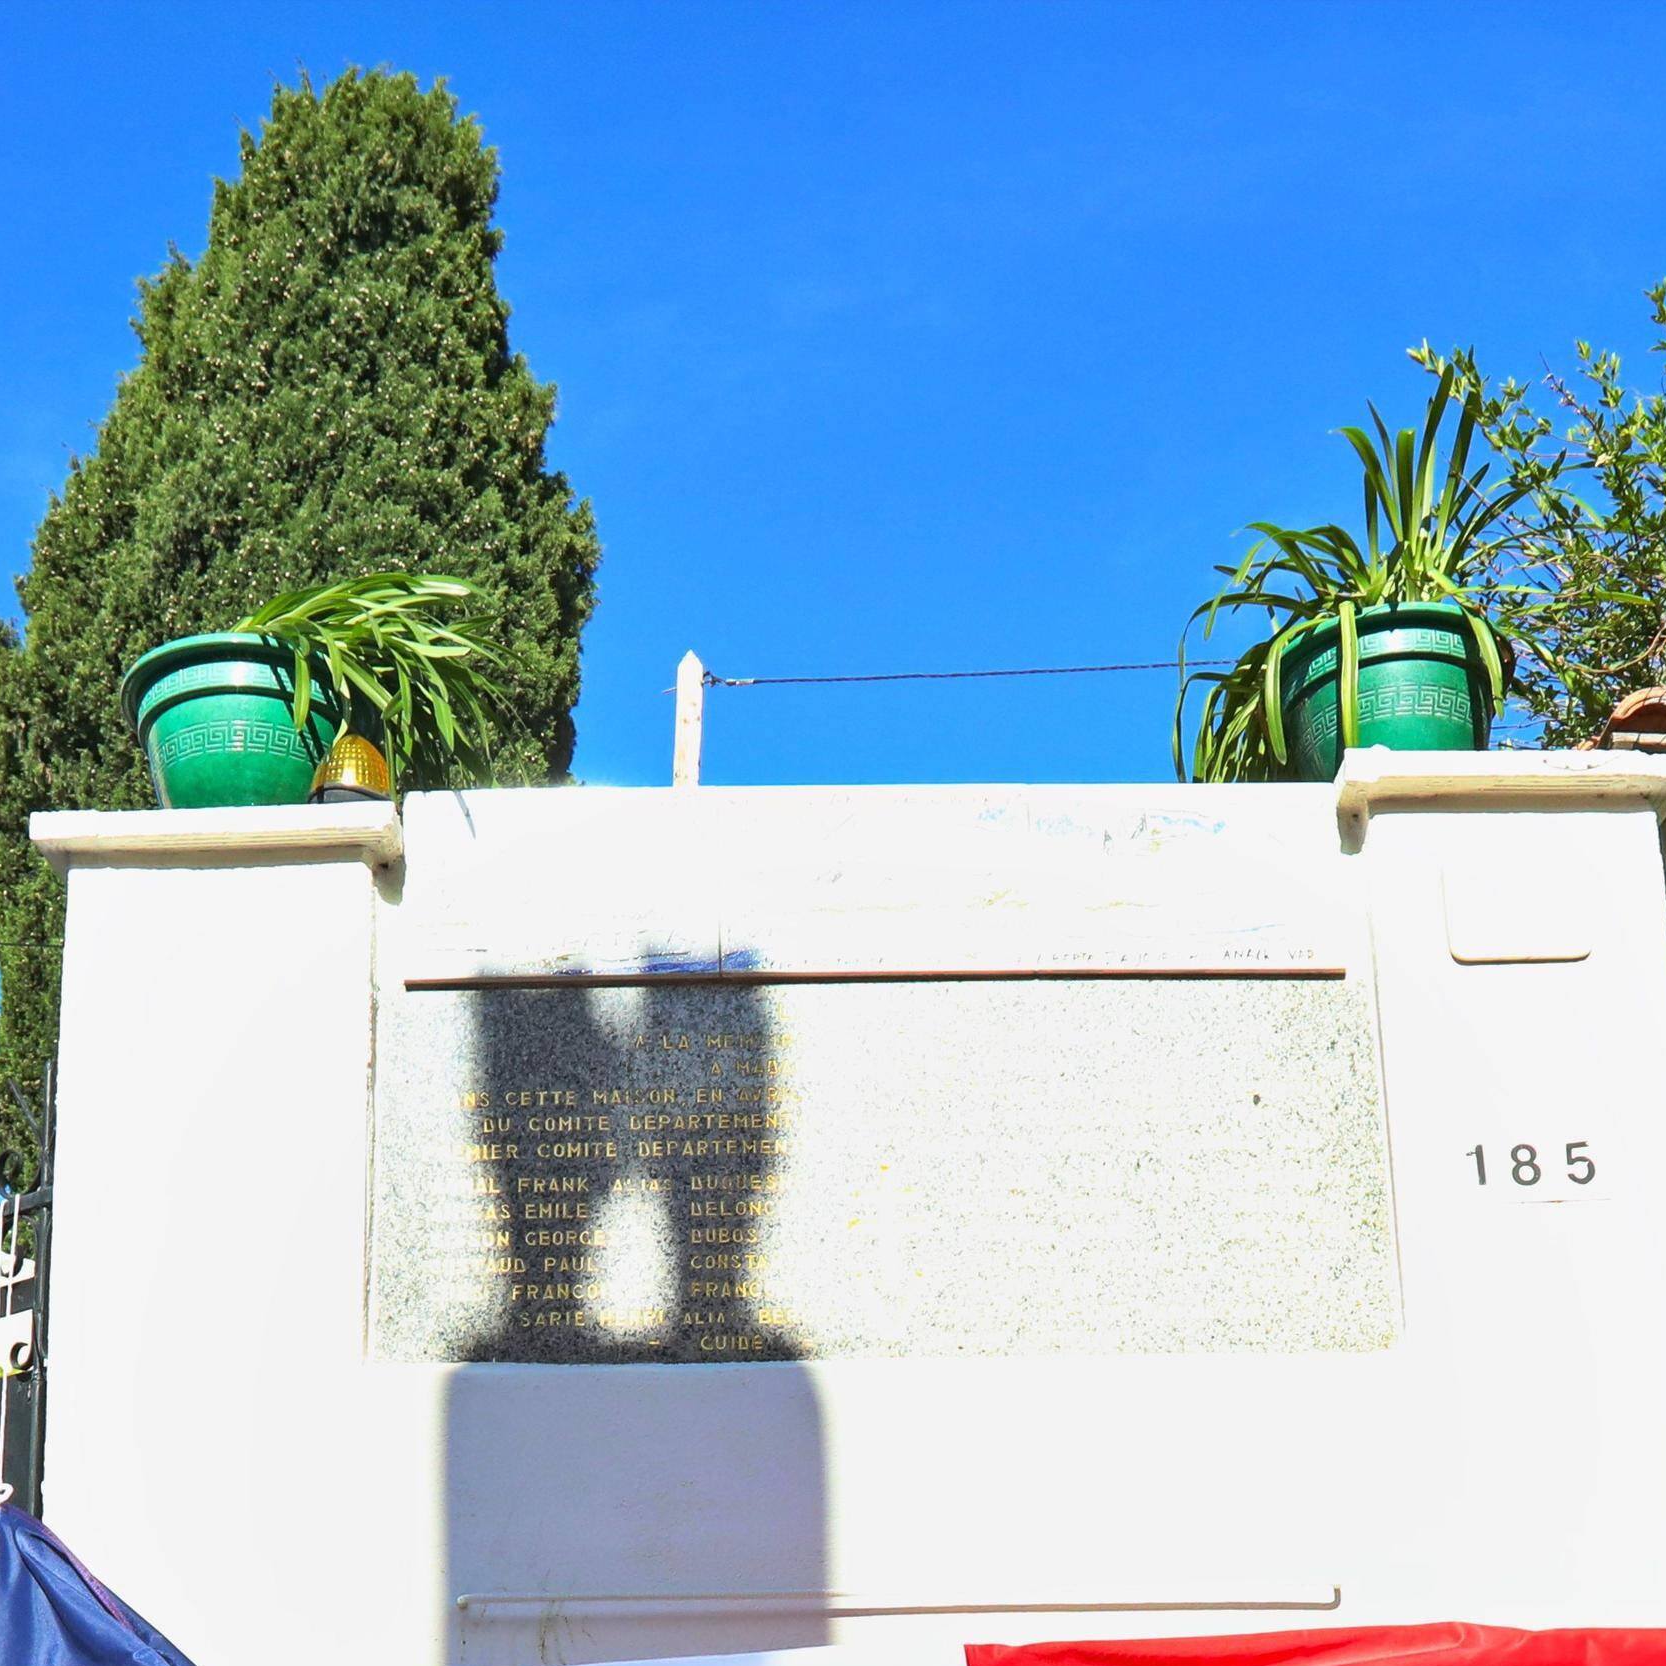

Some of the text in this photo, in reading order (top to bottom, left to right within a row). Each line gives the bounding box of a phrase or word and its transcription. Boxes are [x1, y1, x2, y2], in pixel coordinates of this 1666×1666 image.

[663, 1033, 690, 1050] LA
[505, 1090, 576, 1107] CETTE
[696, 1088, 723, 1104] EN
[483, 1115, 511, 1133] DU
[529, 1115, 611, 1133] COMITE
[537, 1142, 618, 1159] COMITE
[638, 1138, 791, 1157] DEPARTEMEN
[1465, 1140, 1596, 1187] 185
[517, 1176, 591, 1194] FRANK
[690, 1173, 781, 1192] DUQUES
[524, 1203, 589, 1219] EMILE
[543, 1256, 601, 1274] PAUL
